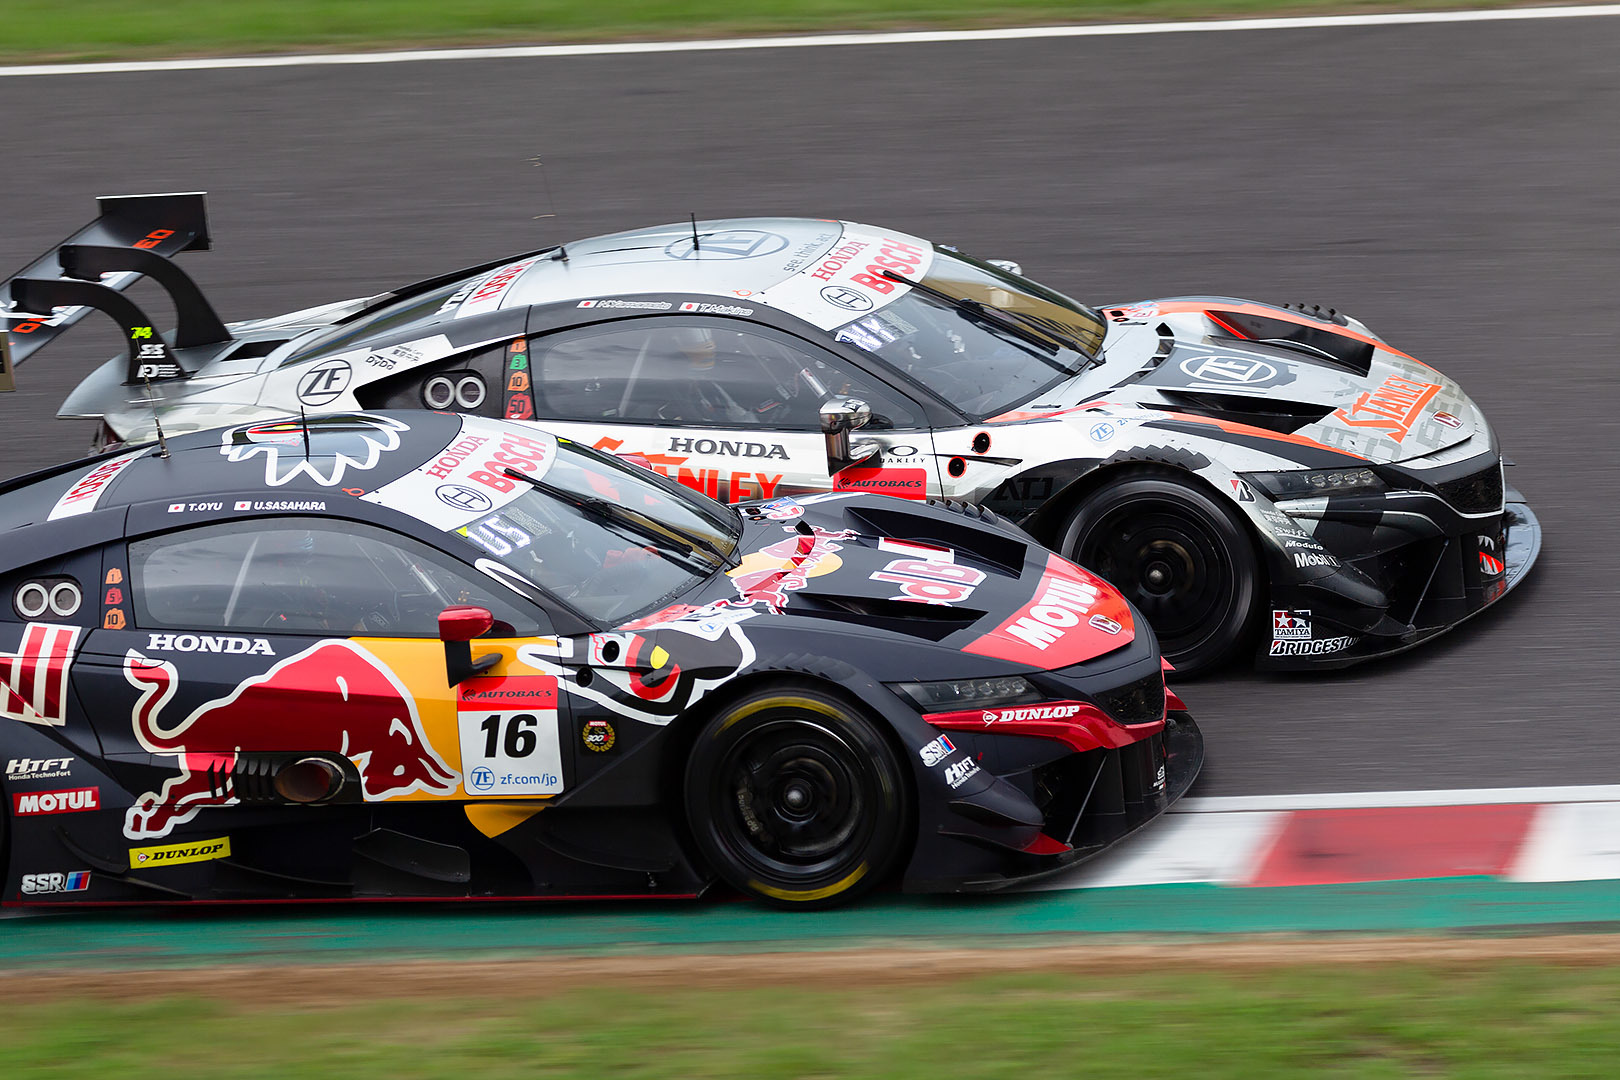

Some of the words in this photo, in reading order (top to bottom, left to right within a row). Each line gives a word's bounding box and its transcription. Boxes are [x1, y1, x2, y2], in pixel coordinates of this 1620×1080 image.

[811, 239, 870, 282] HONDA
[850, 237, 923, 295] BOSCH
[365, 355, 395, 371] DyDo
[299, 363, 351, 401] ZF
[511, 376, 523, 387] 10
[509, 399, 526, 414] 50
[1332, 374, 1443, 444] STANLEY
[425, 435, 490, 480] HONDA
[668, 436, 790, 460] HONDA
[467, 432, 547, 494] BOSCH
[850, 479, 923, 489] AUTOBACS
[188, 502, 223, 511] T.OYU
[253, 501, 326, 511] U.SASAHARA
[1274, 526, 1308, 537] Swift
[1285, 540, 1324, 551] Modulo
[107, 613, 118, 625] 10
[1005, 577, 1098, 651] MOTUL
[1275, 628, 1311, 636] TAMIYA
[146, 633, 276, 656] HONDA
[477, 689, 552, 699] AUTOBACS
[999, 704, 1080, 723] DUNLOP
[480, 713, 538, 759] 16
[8, 773, 31, 781] Honda
[471, 767, 495, 790] ZF
[500, 773, 557, 786] zf.com/jp
[18, 792, 97, 814] MOTUL
[151, 844, 224, 861] DUNLOP
[21, 872, 65, 894] SSR
